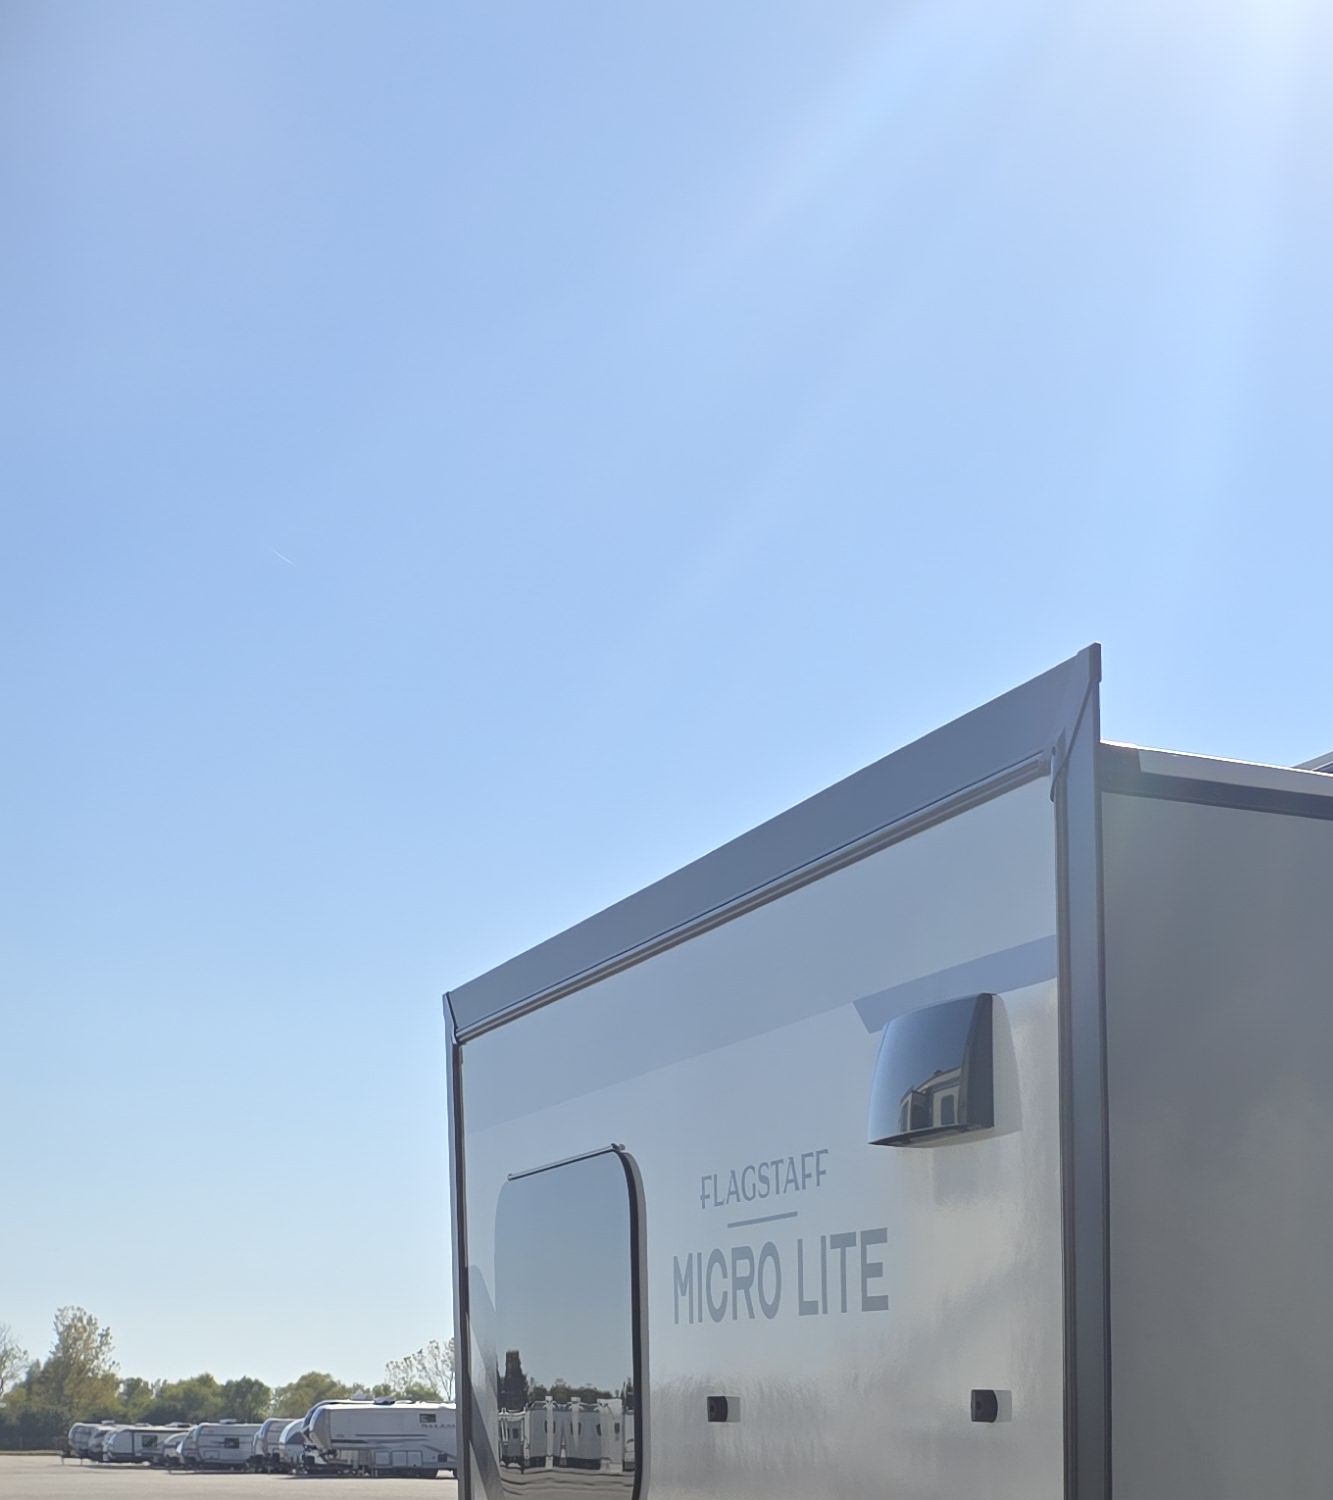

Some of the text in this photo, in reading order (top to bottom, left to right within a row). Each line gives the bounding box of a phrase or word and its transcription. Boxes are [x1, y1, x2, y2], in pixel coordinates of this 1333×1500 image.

[700, 1149, 829, 1209] FLAGSTAFF
[673, 1227, 889, 1325] MICRO LITE
